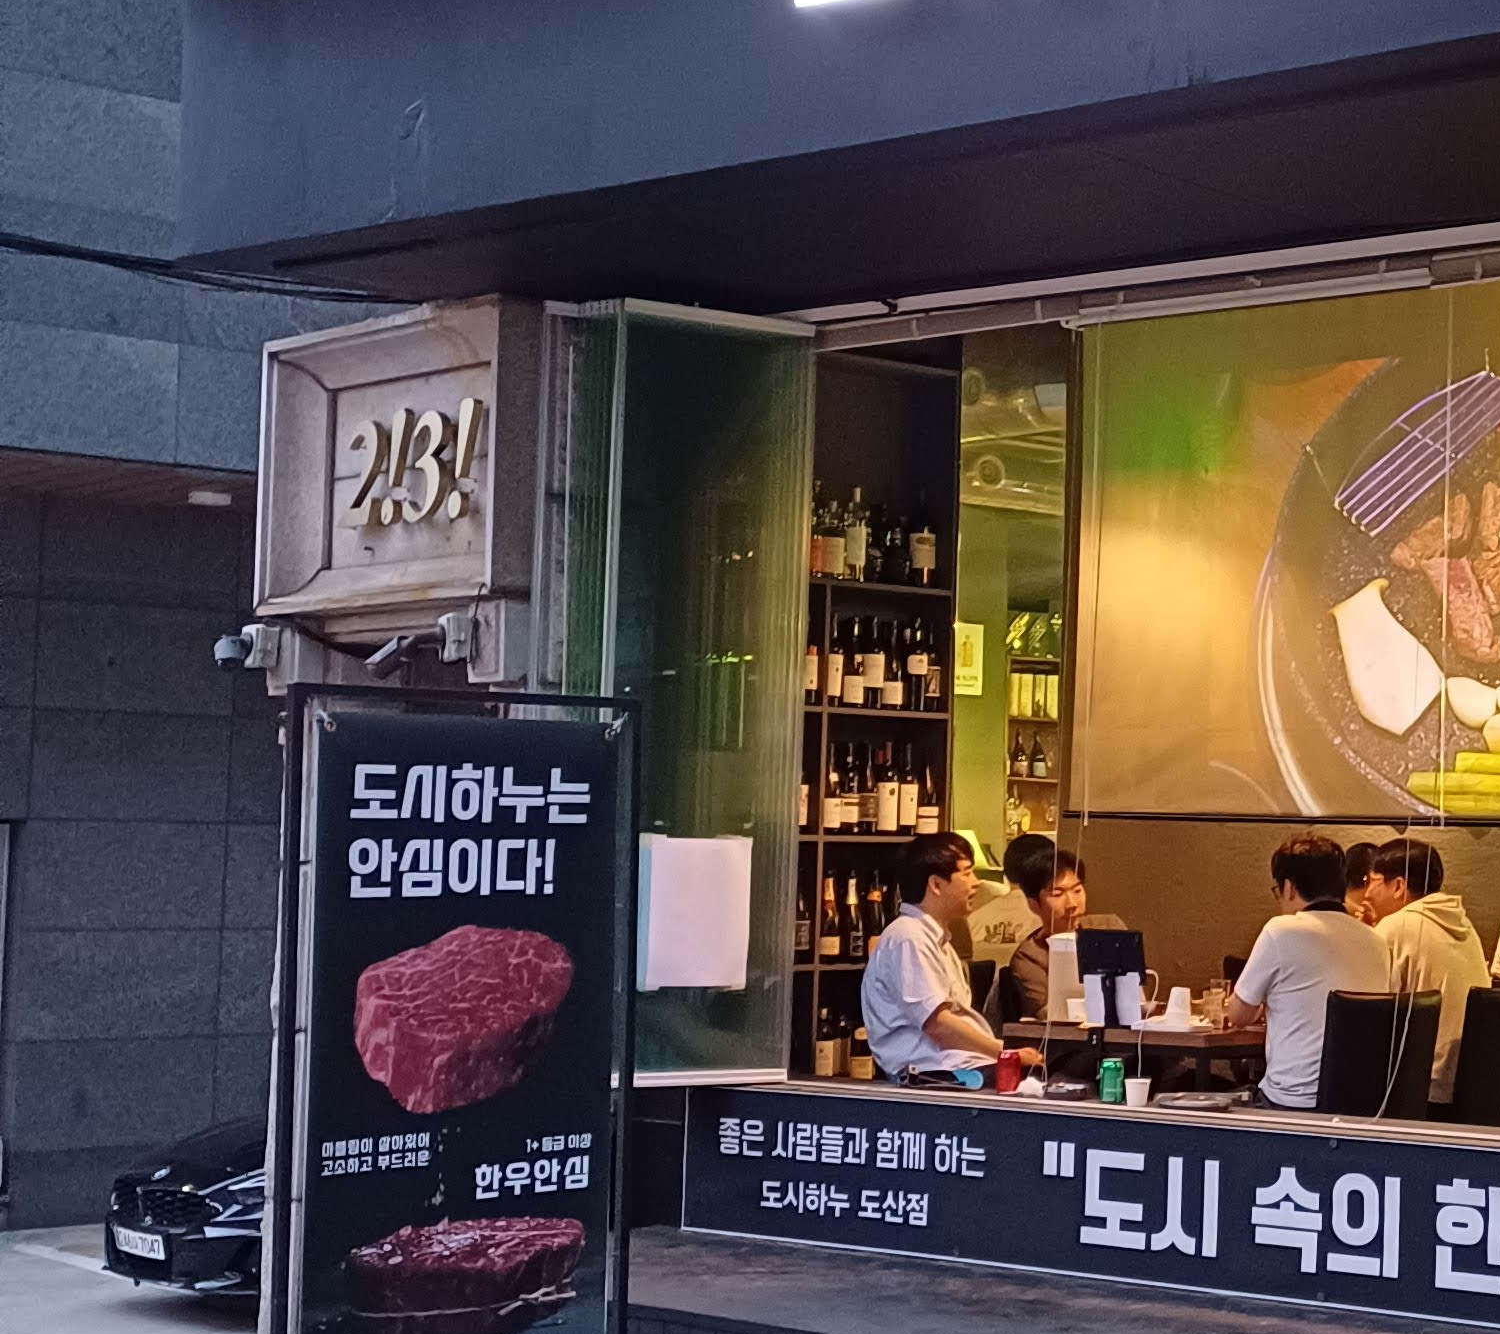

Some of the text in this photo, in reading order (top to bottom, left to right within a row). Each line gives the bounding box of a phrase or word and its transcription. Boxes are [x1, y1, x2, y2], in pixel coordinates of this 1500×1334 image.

[349, 762, 592, 825] 도시하누는
[348, 837, 556, 899] 안심이다!
[321, 1150, 431, 1177] 고소하고 부드러운
[525, 1133, 592, 1154] 1+ 등급 이상
[717, 1116, 987, 1178] 좋은 사람들과 함께 하는
[474, 1154, 590, 1201] 한우안심
[759, 1179, 930, 1227] 도시하누 도산점
[1043, 1139, 1220, 1258] "도시
[1249, 1164, 1399, 1280] 속의
